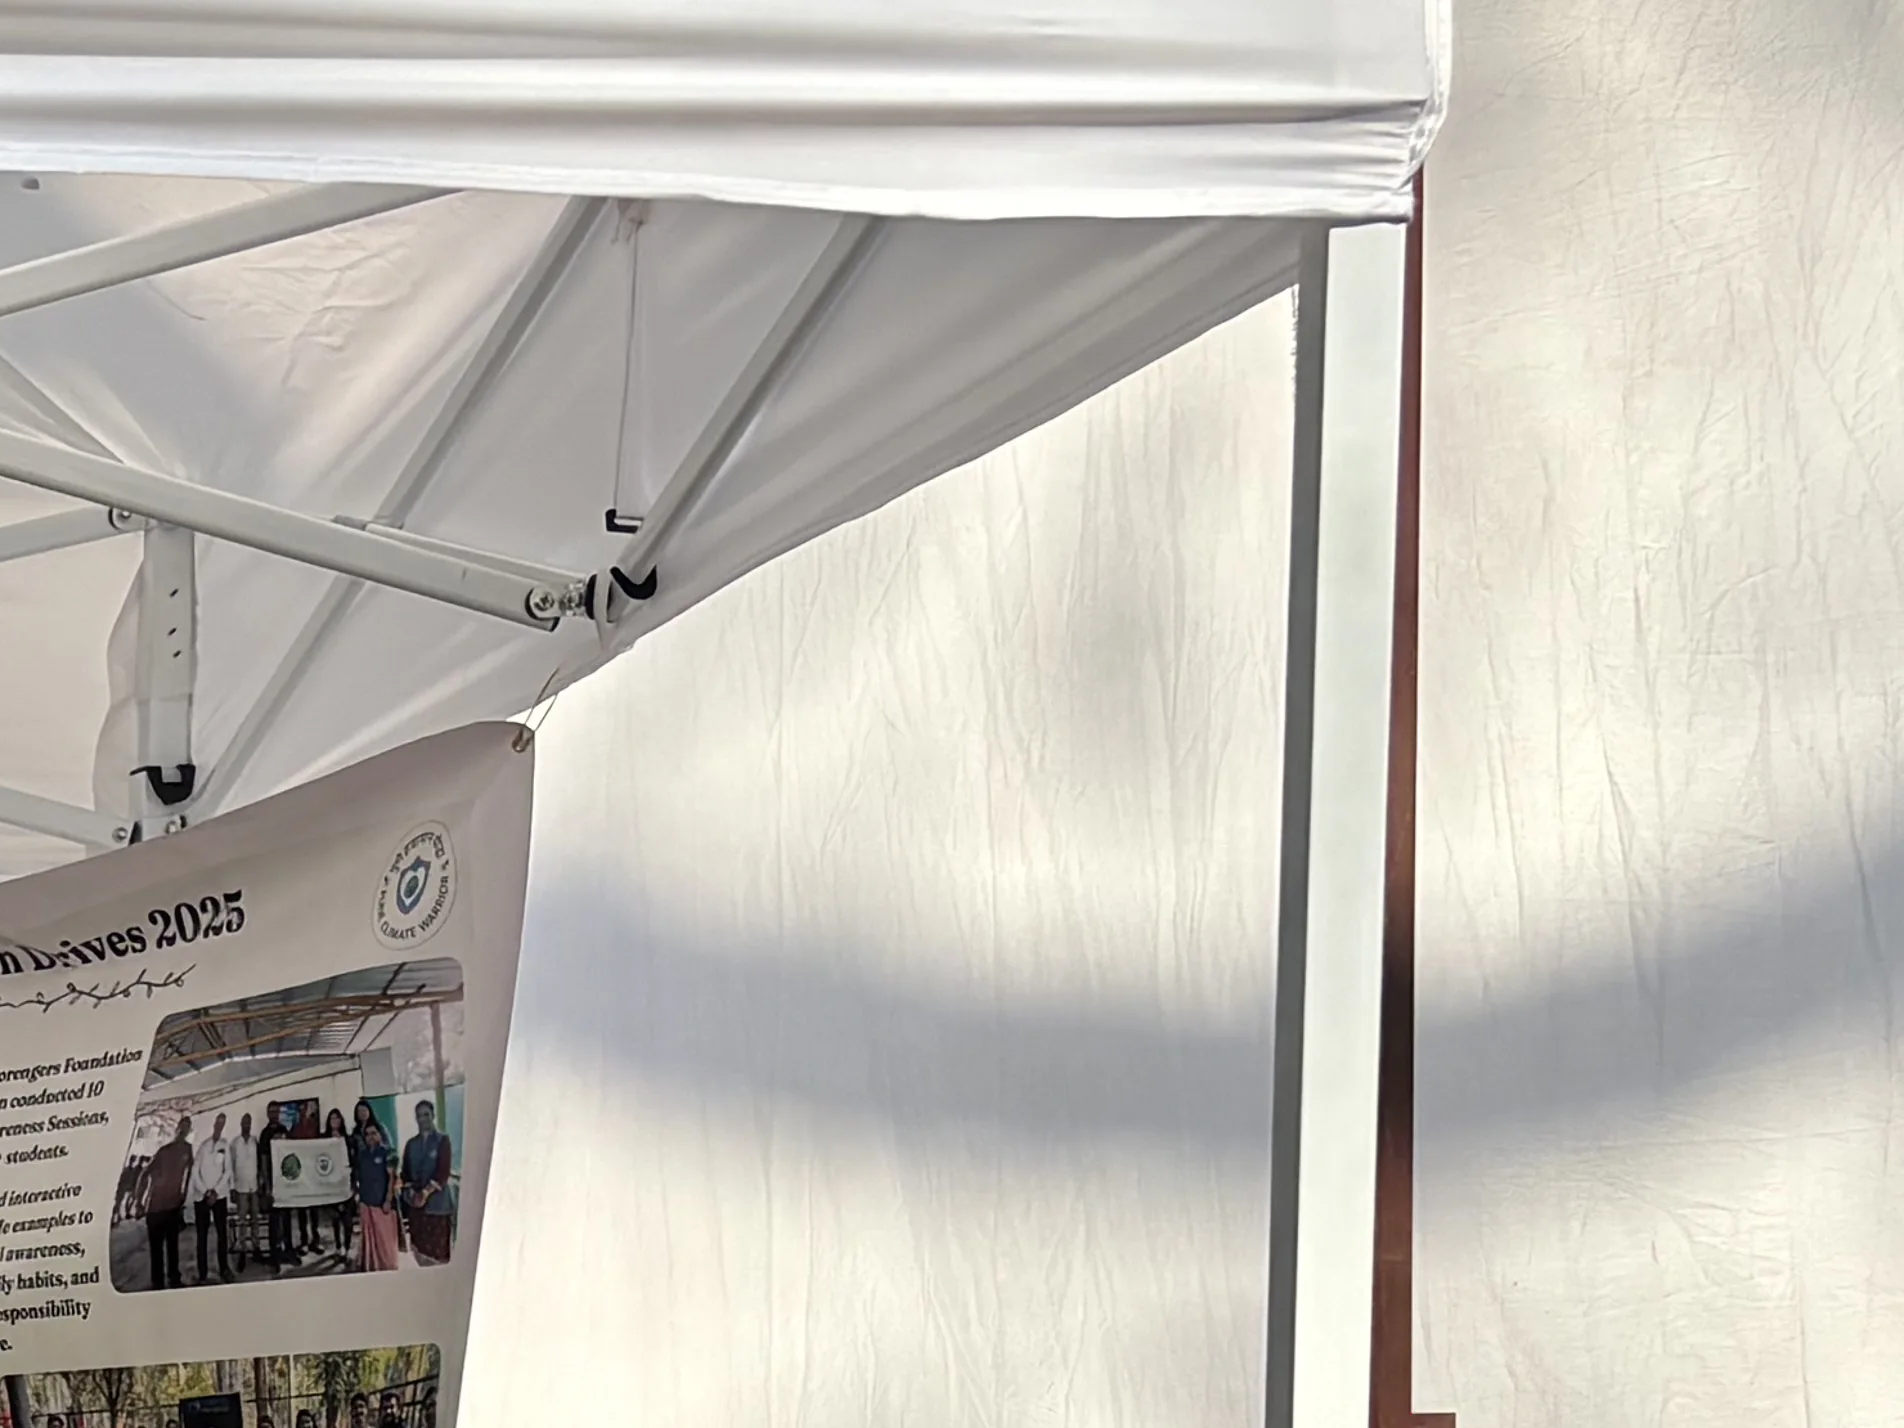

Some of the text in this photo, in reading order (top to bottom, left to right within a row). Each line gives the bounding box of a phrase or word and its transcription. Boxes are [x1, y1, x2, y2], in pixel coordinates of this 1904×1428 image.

[148, 889, 246, 950] 2025
[64, 1048, 144, 1074] Foundation
[10, 1083, 84, 1109] conducted
[86, 1080, 105, 1099] 10
[8, 1183, 82, 1206] interactive
[78, 1209, 94, 1224] to
[17, 1271, 69, 1291] habits,
[71, 1266, 100, 1286] and
